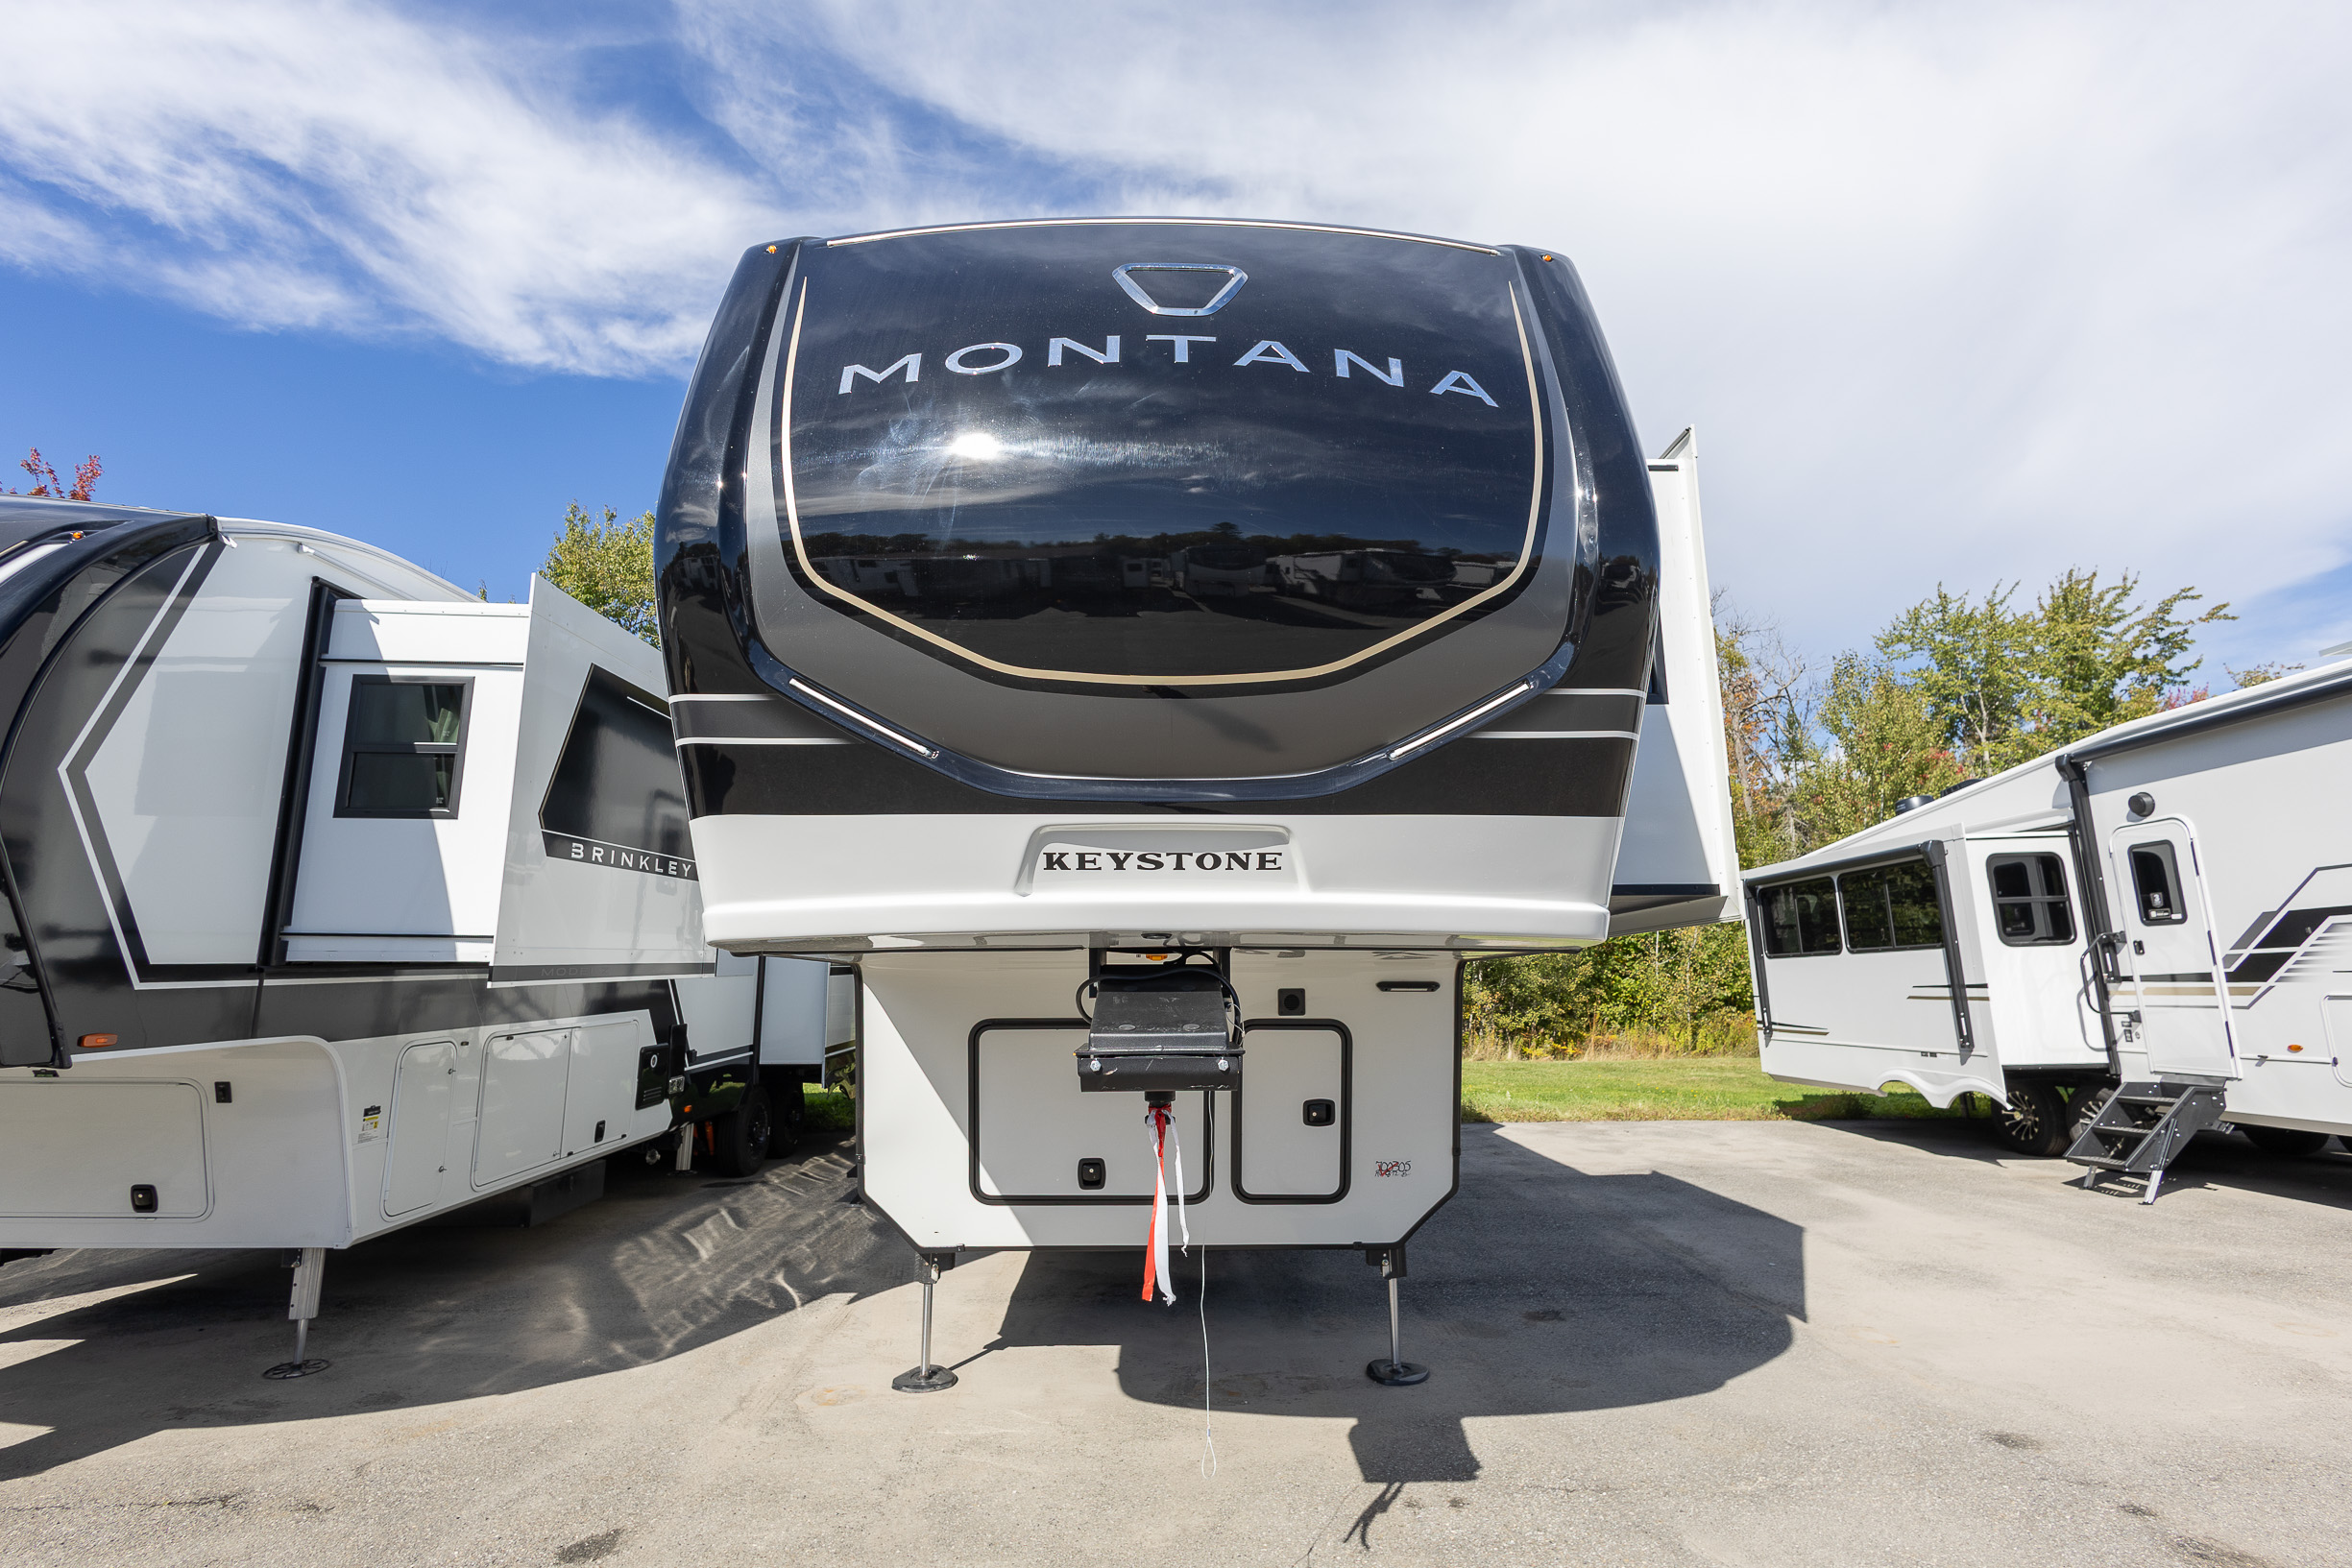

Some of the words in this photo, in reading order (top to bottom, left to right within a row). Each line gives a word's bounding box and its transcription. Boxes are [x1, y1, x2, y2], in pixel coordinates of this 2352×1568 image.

[838, 334, 1498, 407] MONTANA
[570, 842, 691, 878] BRINKLEY
[1042, 852, 1283, 871] KEYSTONE
